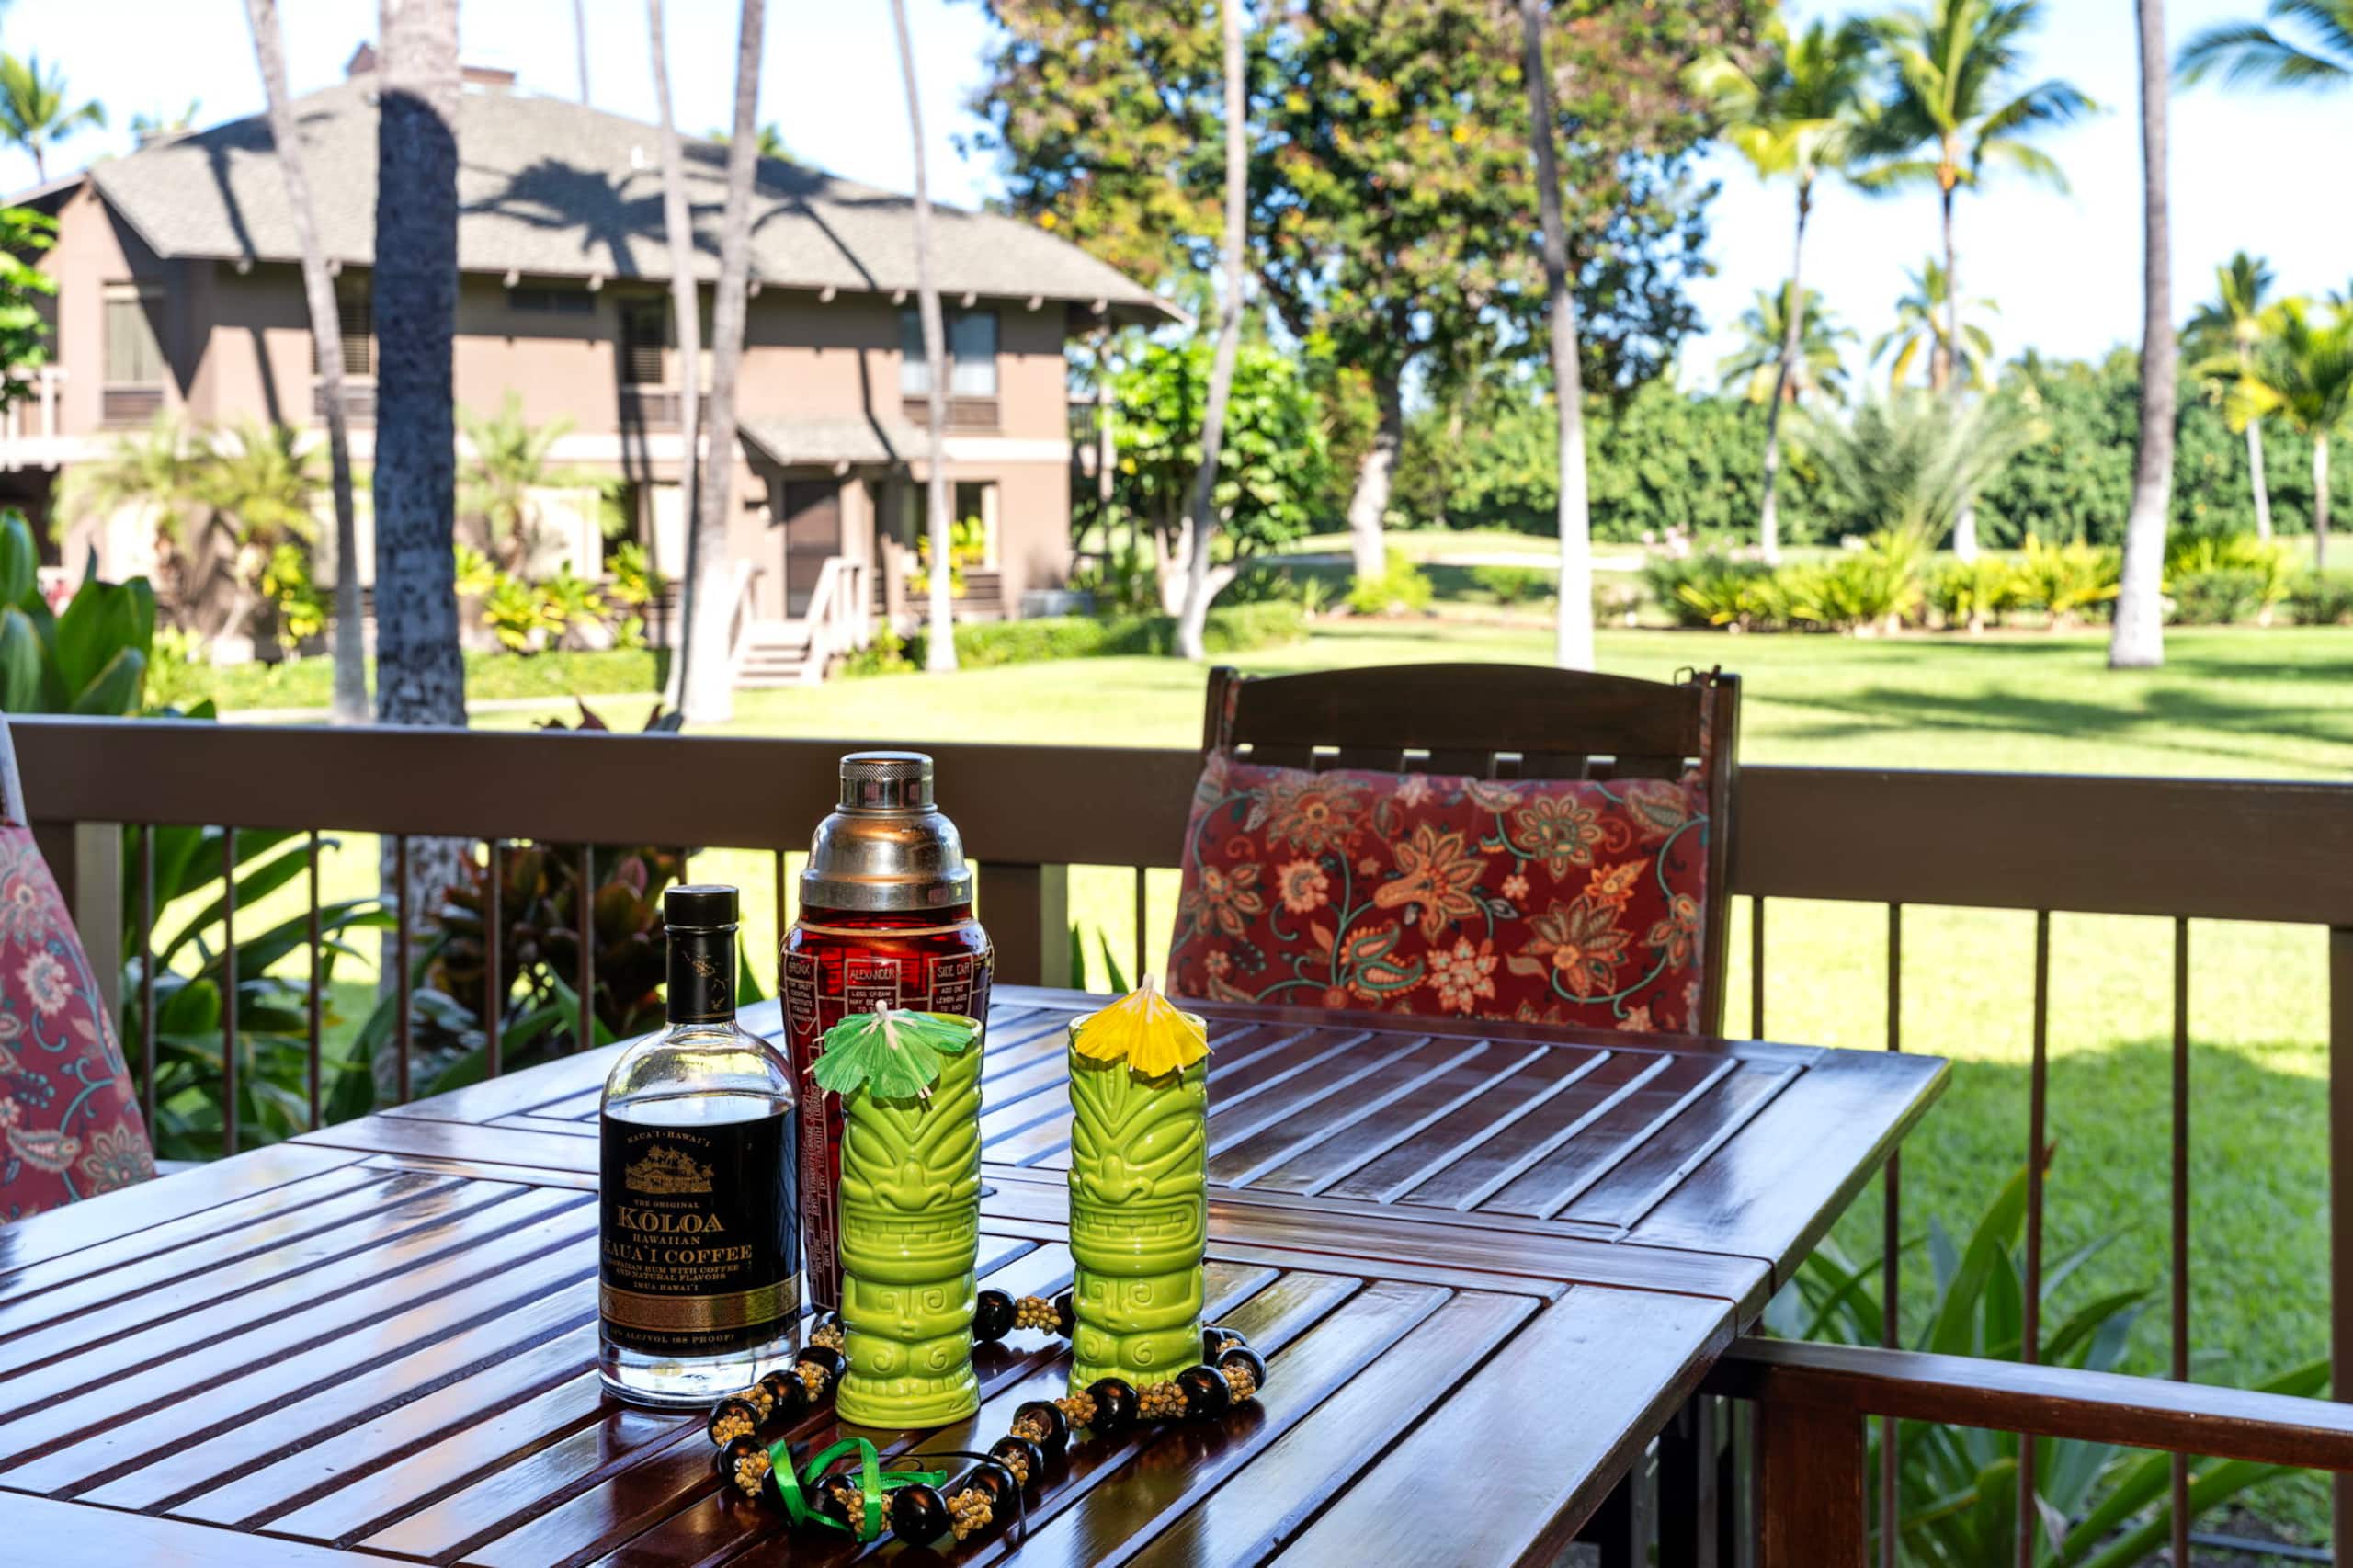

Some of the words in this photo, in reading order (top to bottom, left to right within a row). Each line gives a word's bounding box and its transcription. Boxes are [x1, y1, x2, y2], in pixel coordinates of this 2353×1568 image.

[849, 968, 895, 981] ALEXANDER
[937, 964, 955, 978] SIDE
[956, 962, 971, 975] CAR
[634, 1199, 651, 1207] THE
[617, 1206, 726, 1233] KŌLOA
[632, 1233, 700, 1245] HAWAIIAN
[823, 1229, 831, 1246] GIN
[665, 1244, 752, 1264] COFFEE
[823, 1249, 831, 1267] DRY
[615, 1267, 631, 1278] AND
[631, 1271, 676, 1281] NATURAL
[679, 1272, 727, 1282] FLAVORS
[644, 1265, 666, 1274] RUM
[669, 1265, 698, 1275] WITH
[699, 1263, 740, 1274] COFFEE
[626, 1331, 668, 1344] ALC/VOL
